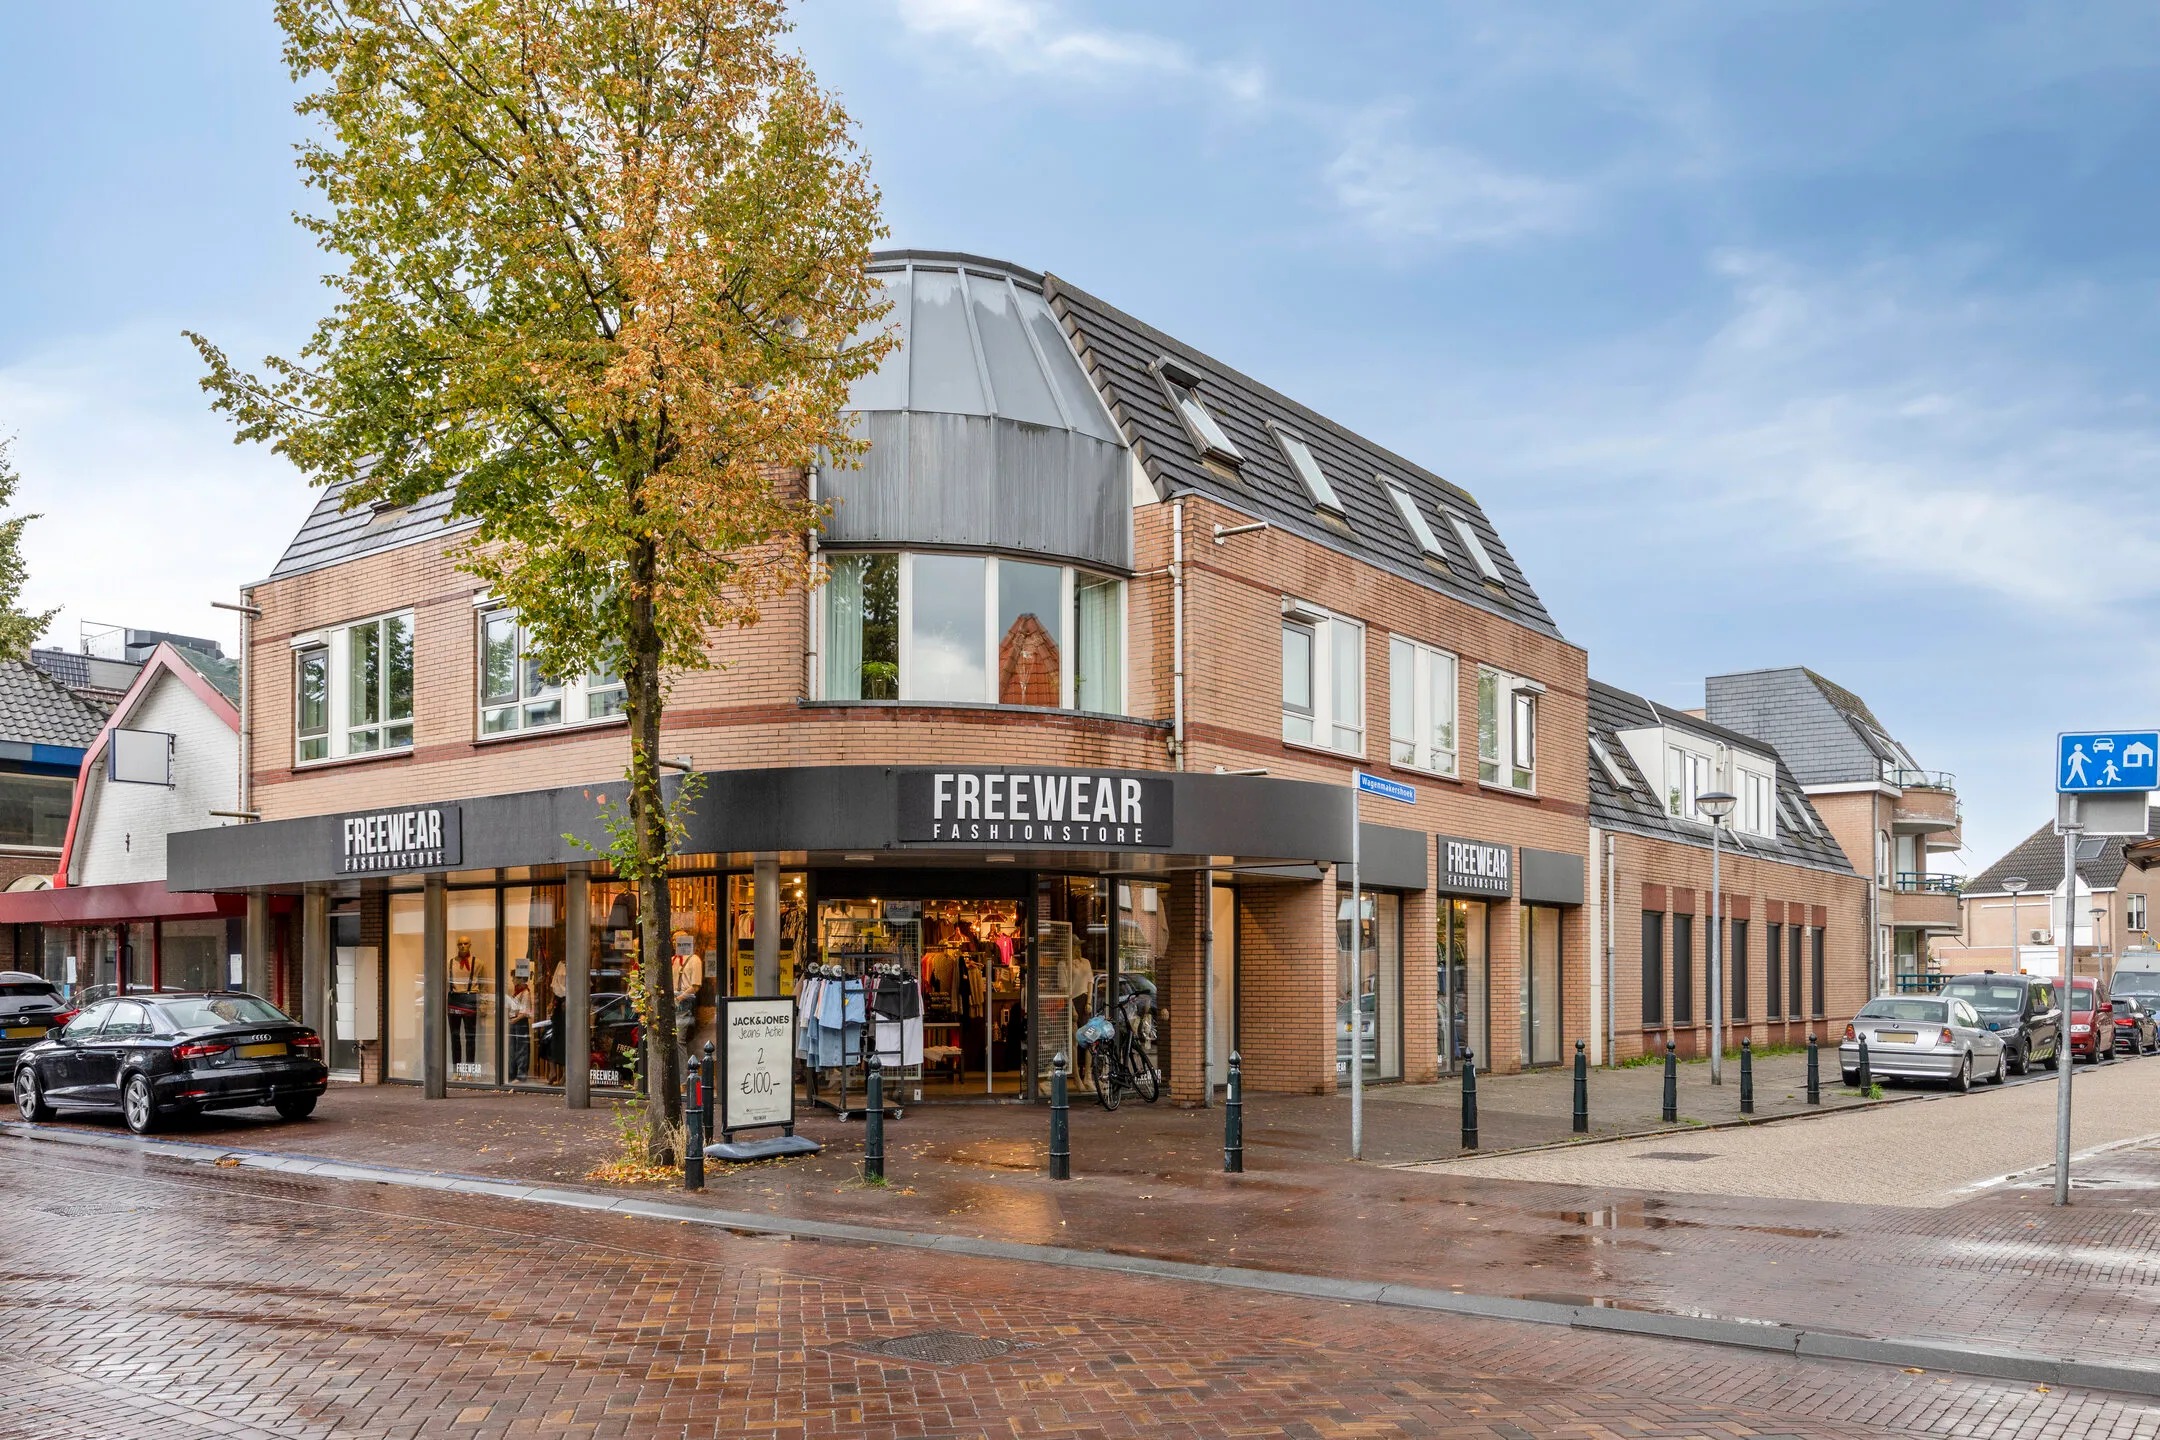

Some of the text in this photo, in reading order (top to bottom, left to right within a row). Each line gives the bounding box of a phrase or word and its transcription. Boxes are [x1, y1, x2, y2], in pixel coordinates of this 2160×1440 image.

[1361, 775, 1414, 799] Wagenmakershoek
[933, 773, 1143, 824] FREEWEAR
[344, 809, 442, 856] FREEWEAR
[933, 823, 1143, 843] FASHIONSTORE
[345, 850, 442, 871] FASHIONSTORE
[1447, 841, 1508, 879] FREEWEAR
[732, 1015, 790, 1026] JACK&JONES
[738, 1027, 761, 1040] Jeans
[757, 1047, 765, 1065] 2
[590, 1069, 619, 1081] FREEWEAR
[740, 1071, 781, 1096] €100,-
